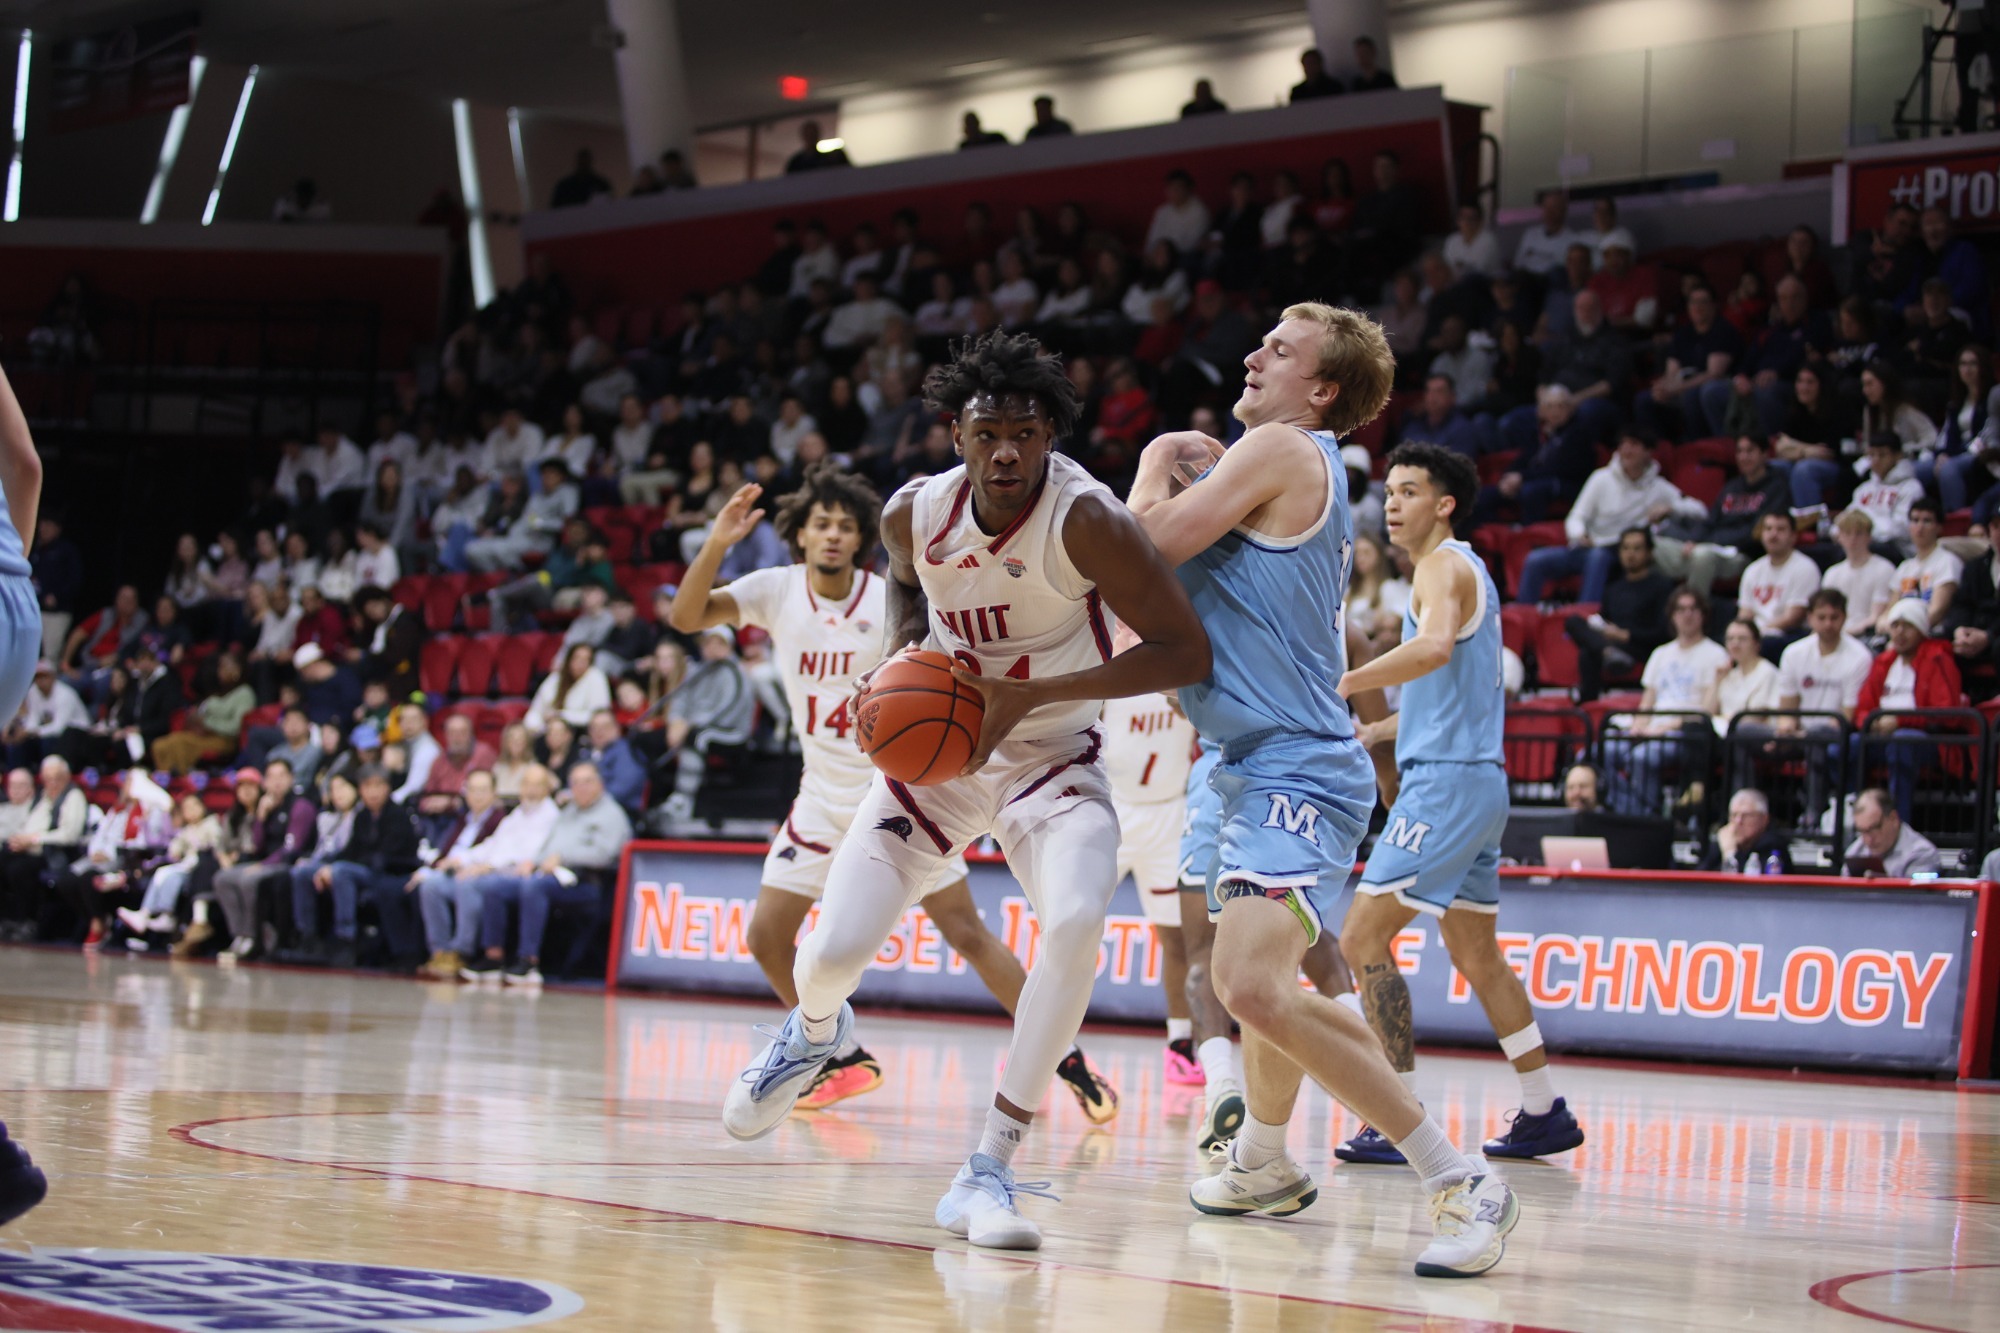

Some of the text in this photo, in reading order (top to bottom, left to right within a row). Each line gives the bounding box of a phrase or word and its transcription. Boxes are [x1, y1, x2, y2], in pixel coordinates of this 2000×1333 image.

[1889, 165, 2000, 219] #Pro
[936, 604, 1011, 650] NJIT
[799, 651, 856, 681] NJIT
[806, 694, 853, 738] 14
[1129, 711, 1175, 737] NJIT
[1141, 752, 1158, 785] 1
[1260, 792, 1323, 847] M
[1382, 815, 1433, 856] M
